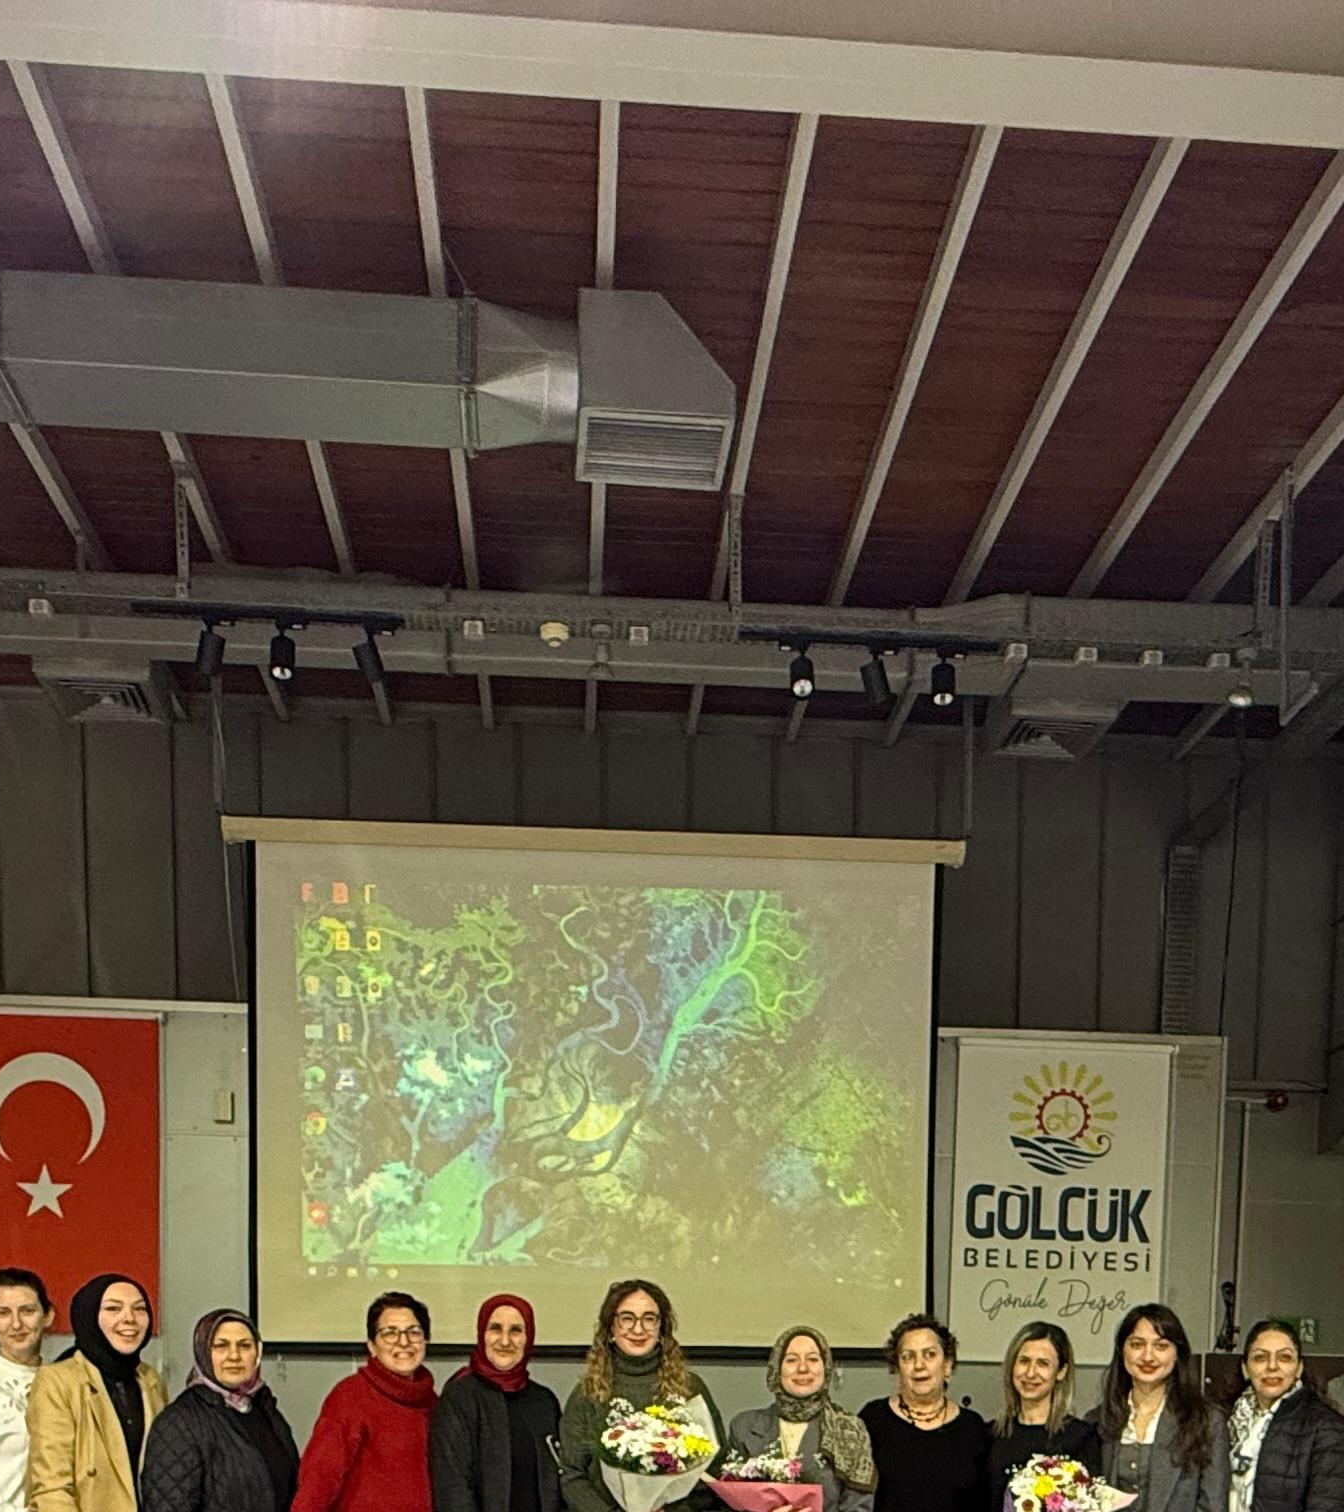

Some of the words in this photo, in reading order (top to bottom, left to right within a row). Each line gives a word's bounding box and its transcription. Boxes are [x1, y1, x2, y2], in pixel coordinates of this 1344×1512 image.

[965, 1183, 1153, 1244] GÖLCÜK
[963, 1245, 1151, 1273] BELEDİYESİ
[979, 1276, 1049, 1321] Gönüle
